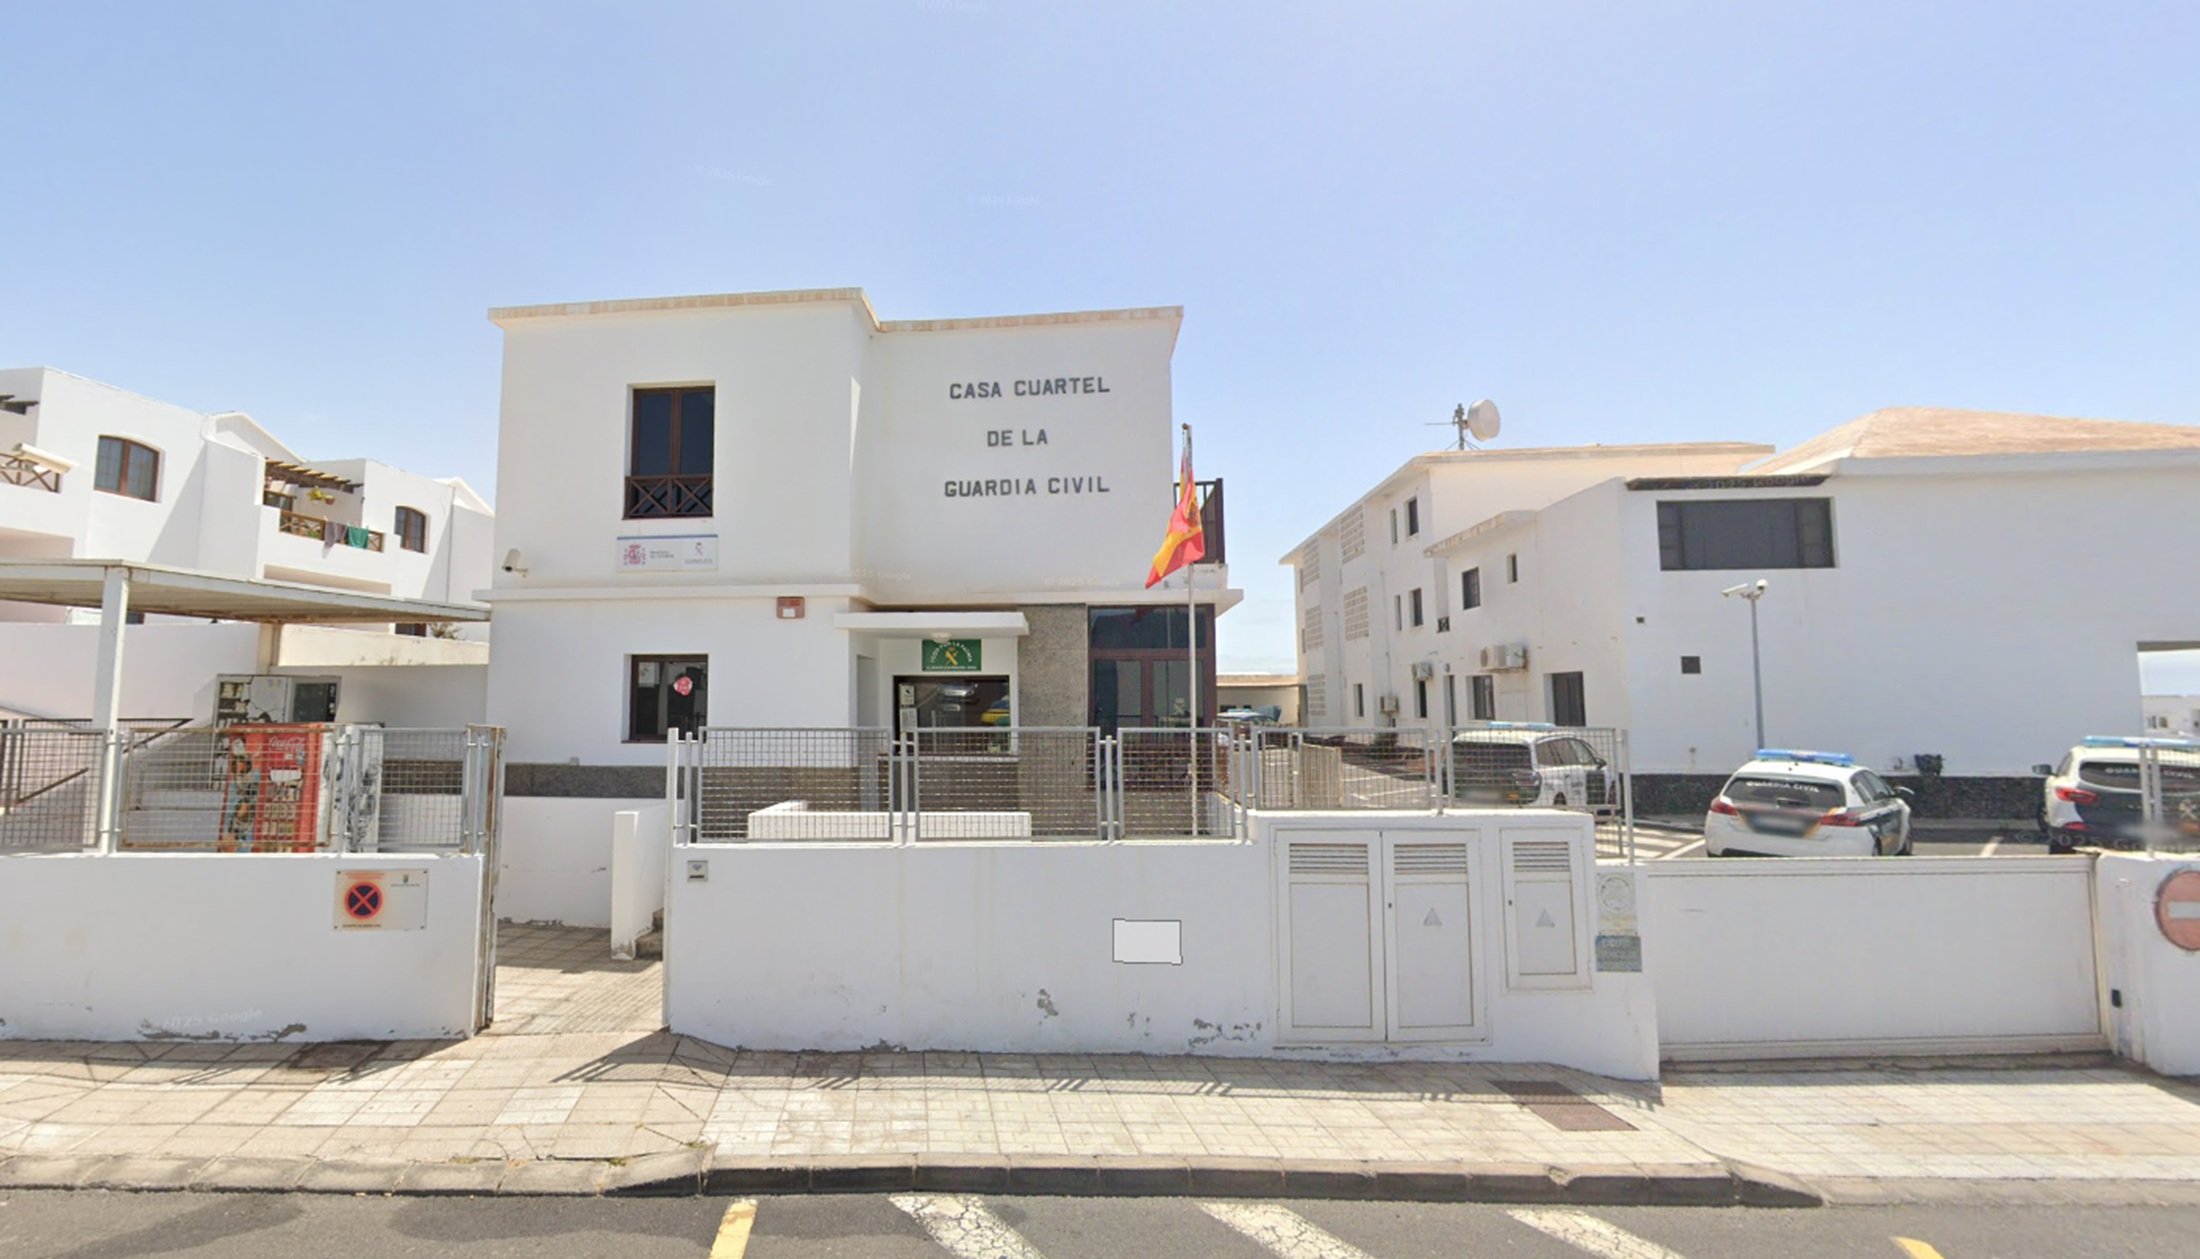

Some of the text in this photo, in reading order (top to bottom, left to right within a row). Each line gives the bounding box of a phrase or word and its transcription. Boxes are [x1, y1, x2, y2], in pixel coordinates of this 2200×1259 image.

[949, 376, 1111, 400] CASA CUARTEL
[987, 428, 1048, 448] DE LA
[944, 476, 1110, 498] GUARDIA CIVIL
[1745, 780, 1820, 793] GUARDIA CIVIL
